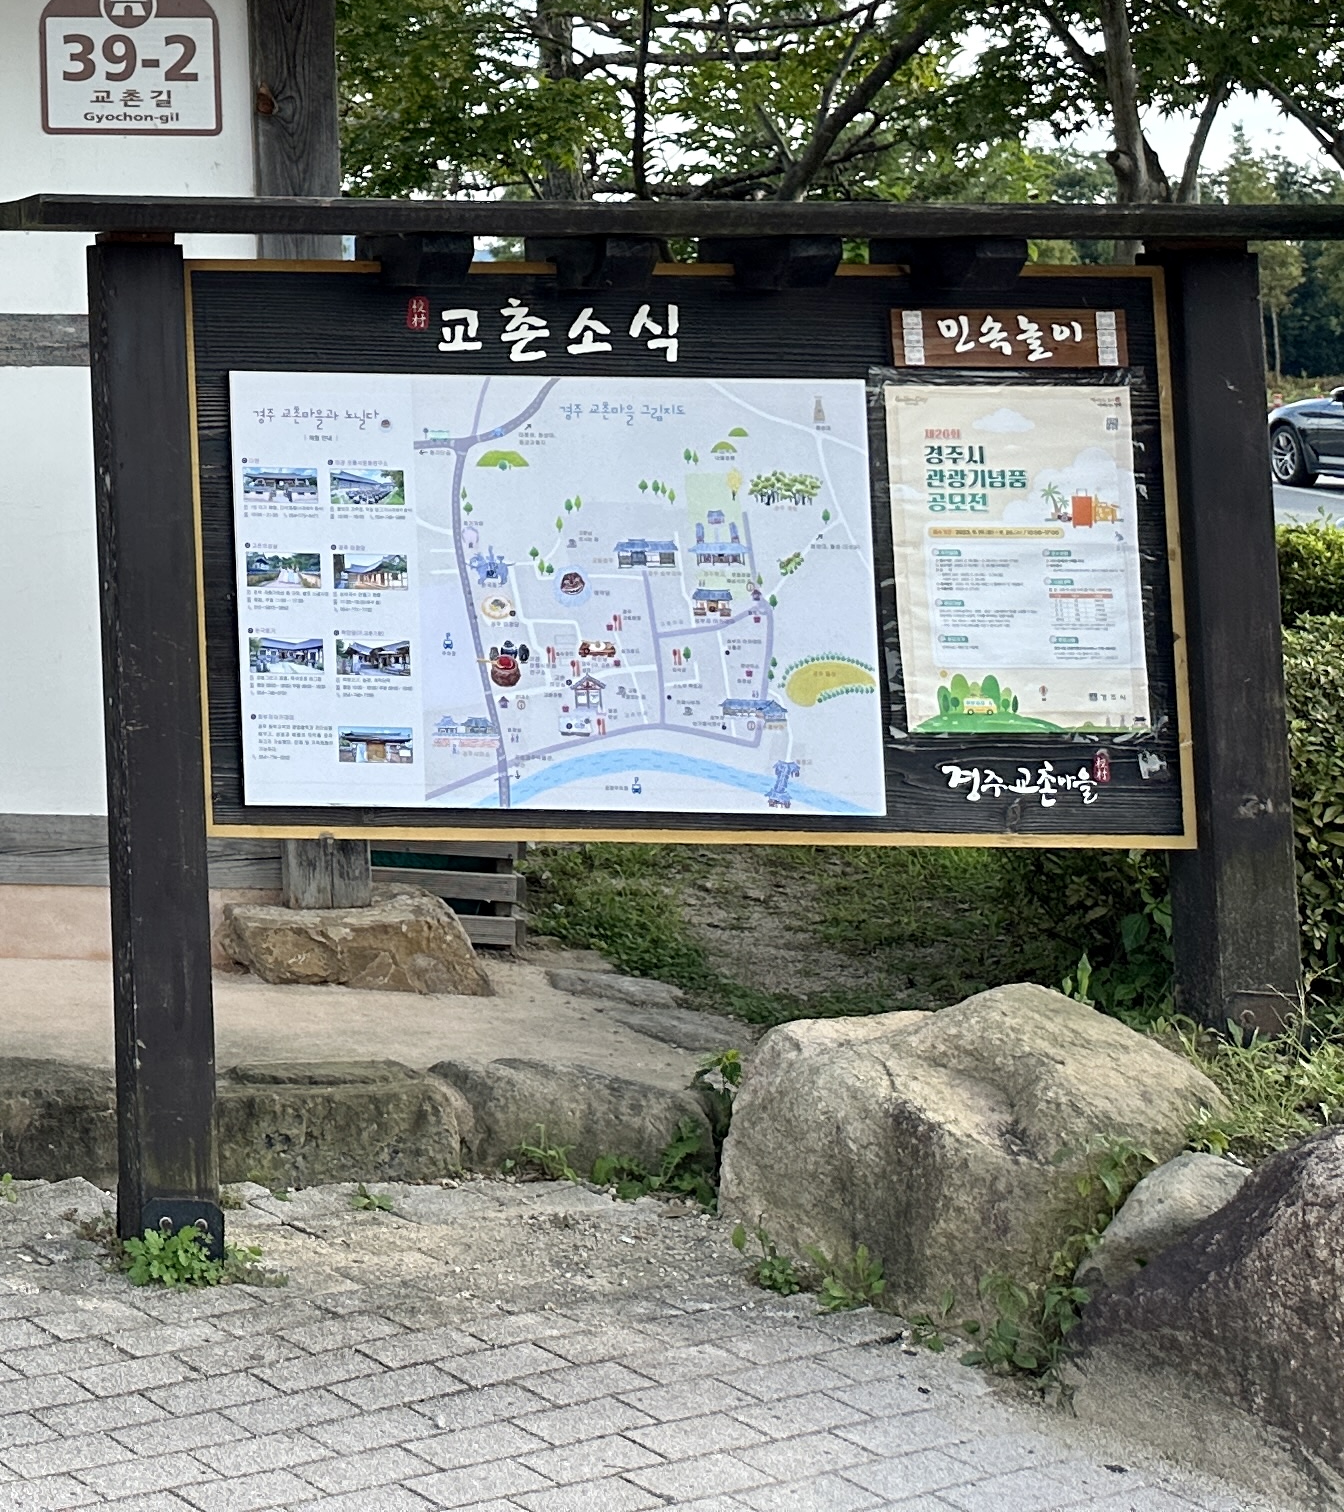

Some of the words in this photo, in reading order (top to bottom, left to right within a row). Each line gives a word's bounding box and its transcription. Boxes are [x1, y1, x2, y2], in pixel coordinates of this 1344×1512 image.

[62, 33, 199, 82] 39-2
[89, 89, 172, 108] 교촌길
[83, 112, 180, 124] Gyochon-gil
[438, 298, 679, 363] 교촌소식
[936, 314, 1083, 362] 민속놀이
[252, 407, 276, 424] 경주
[280, 405, 339, 430] 교촌마을과
[344, 408, 380, 430] 노닐다
[561, 403, 584, 420] 경주
[589, 401, 636, 426] 교촌마을
[640, 403, 686, 422] 그림지도
[924, 444, 985, 465] 경주시
[926, 469, 1028, 488] 관광기념품
[927, 493, 989, 512] 공모전
